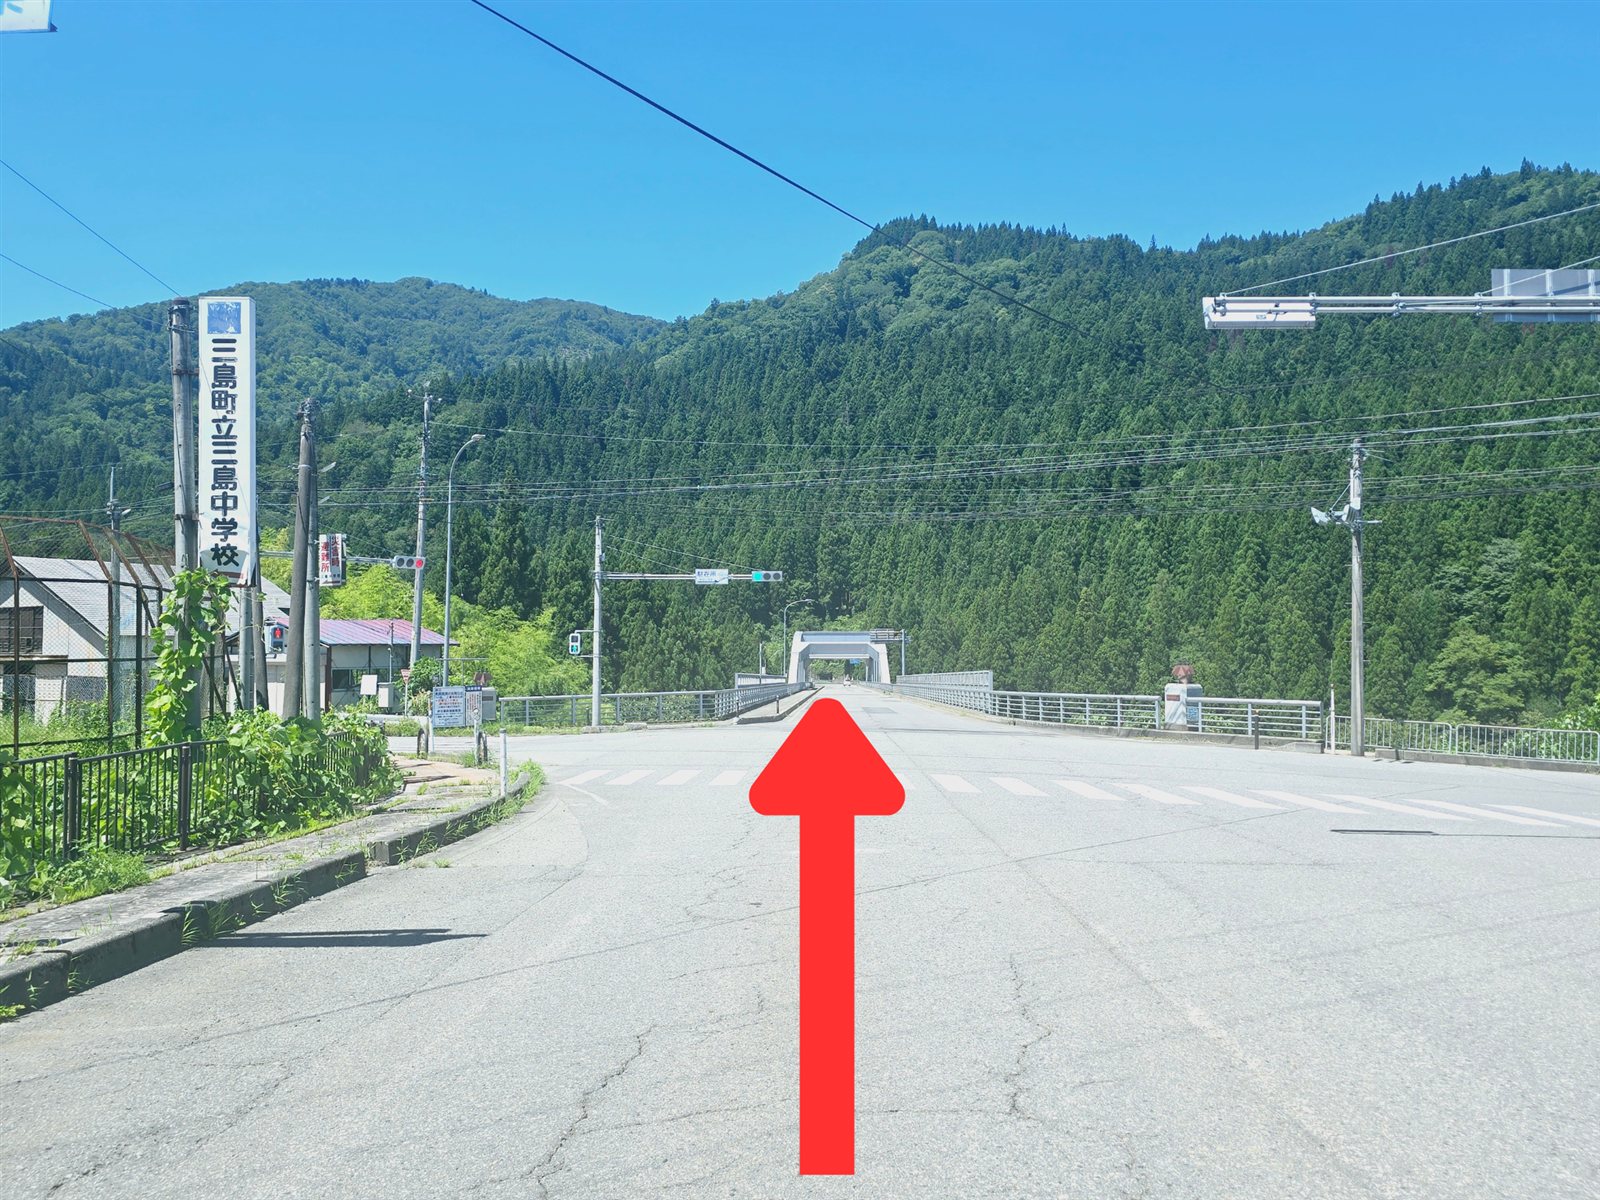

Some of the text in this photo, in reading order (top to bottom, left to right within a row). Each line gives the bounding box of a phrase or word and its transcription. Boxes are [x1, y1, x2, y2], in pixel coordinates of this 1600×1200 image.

[211, 338, 239, 567] 三島町立三島中学校
